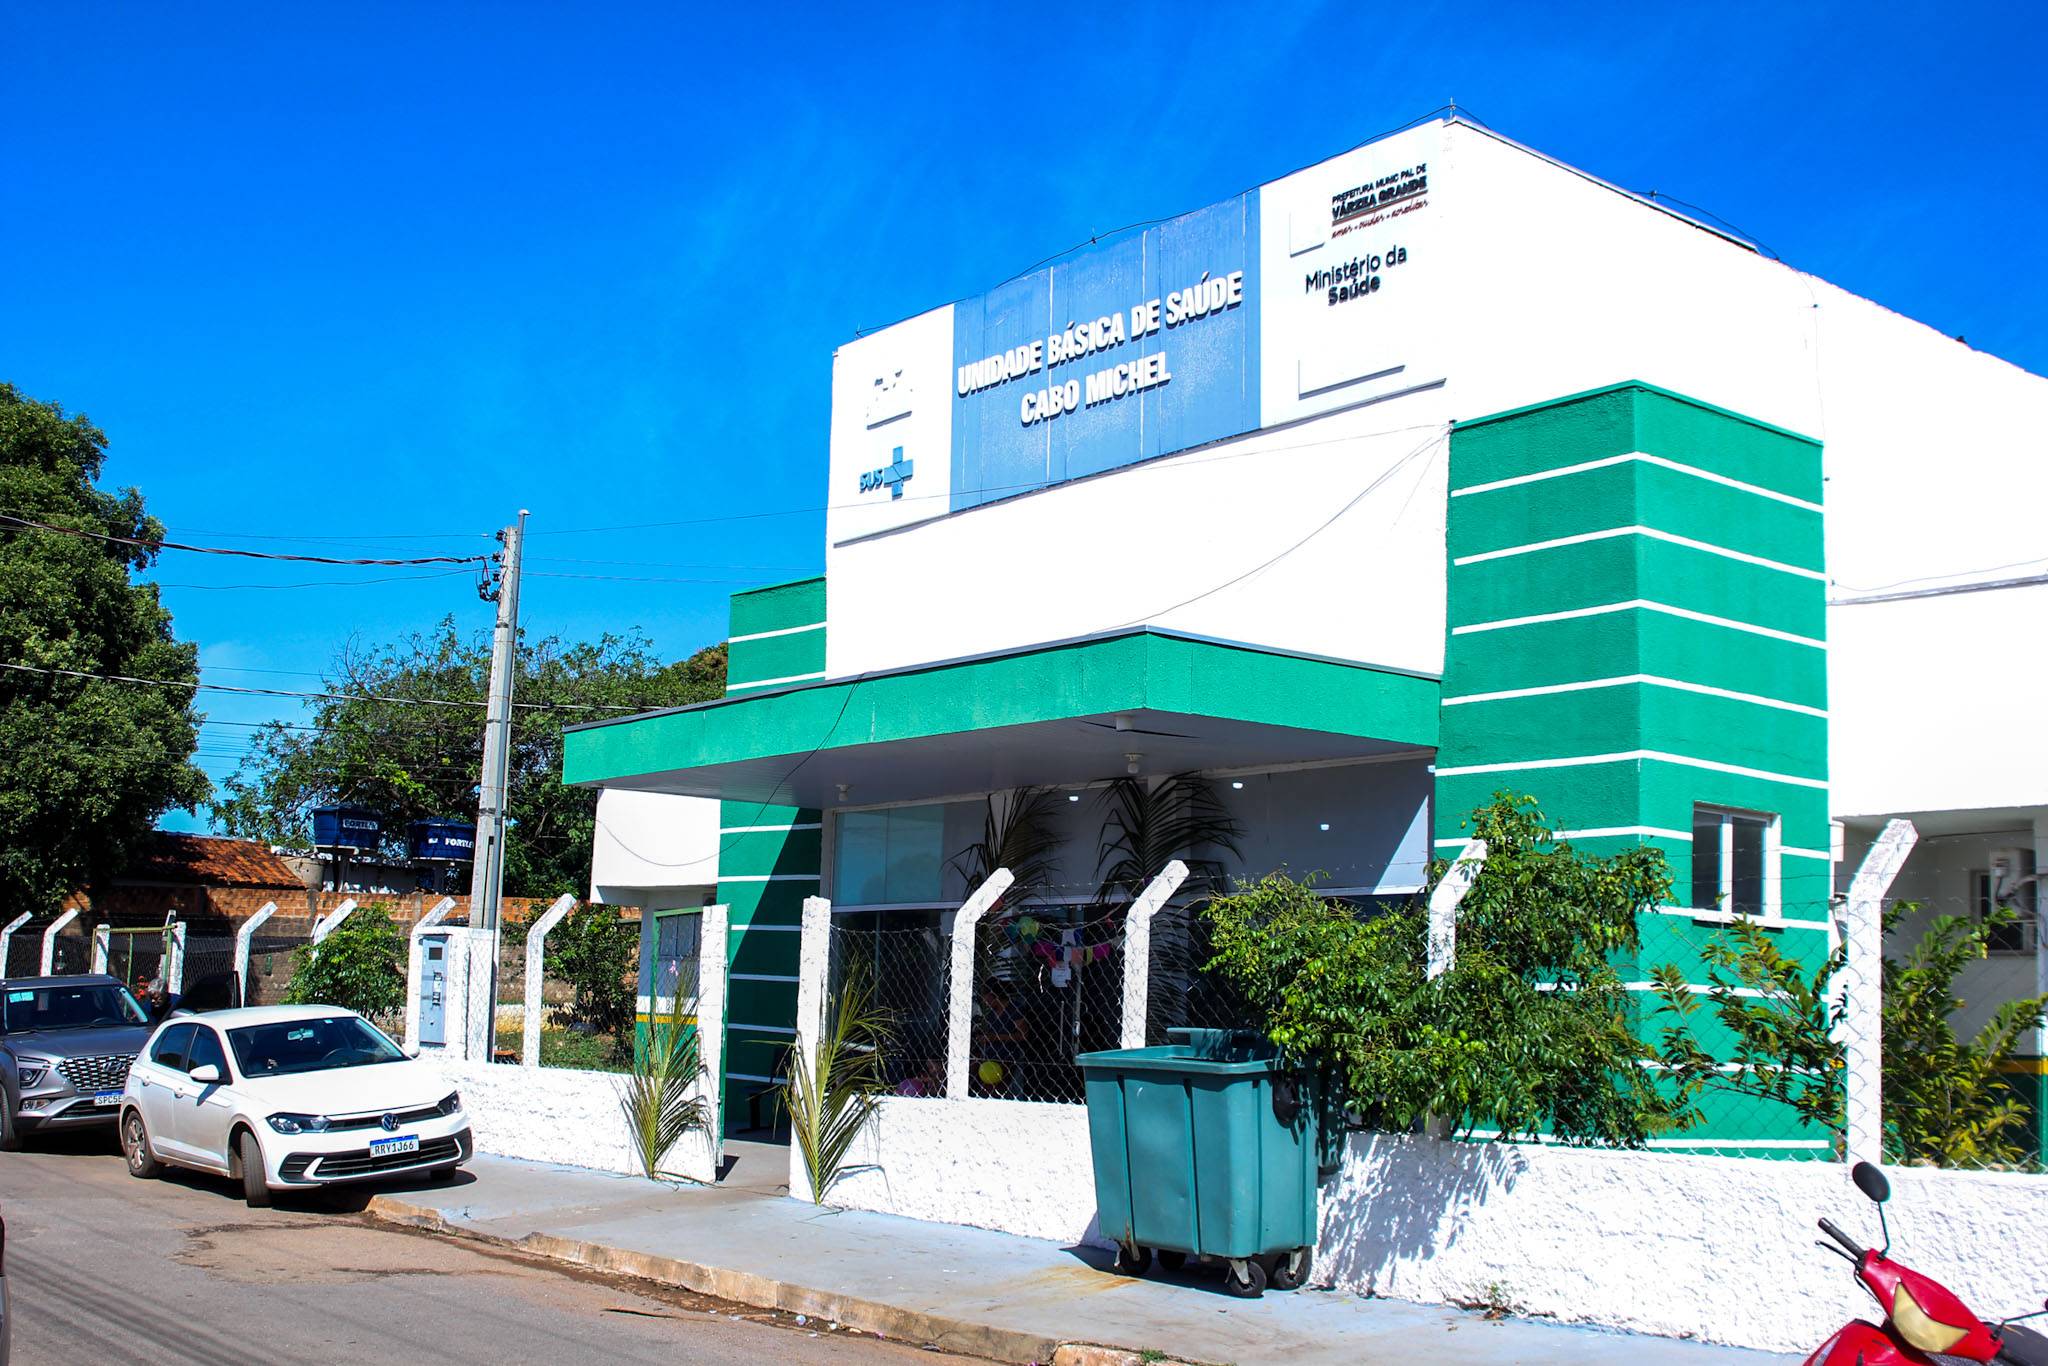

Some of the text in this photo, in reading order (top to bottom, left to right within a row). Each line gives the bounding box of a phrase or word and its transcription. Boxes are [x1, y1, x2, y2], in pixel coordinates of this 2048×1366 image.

[1332, 163, 1427, 206] PREFEITURA MUNICPAL DE
[1378, 175, 1427, 203] GRANDE
[1305, 244, 1407, 295] Ministério da
[1328, 275, 1380, 306] Saúde
[957, 270, 1243, 398] UNIDADE BÁSICA DE SAÚDE
[1020, 352, 1172, 428] CABO MICHEL
[859, 469, 884, 493] SUS
[97, 1095, 123, 1105] SPC5E
[374, 1141, 414, 1155] RRY1J66
